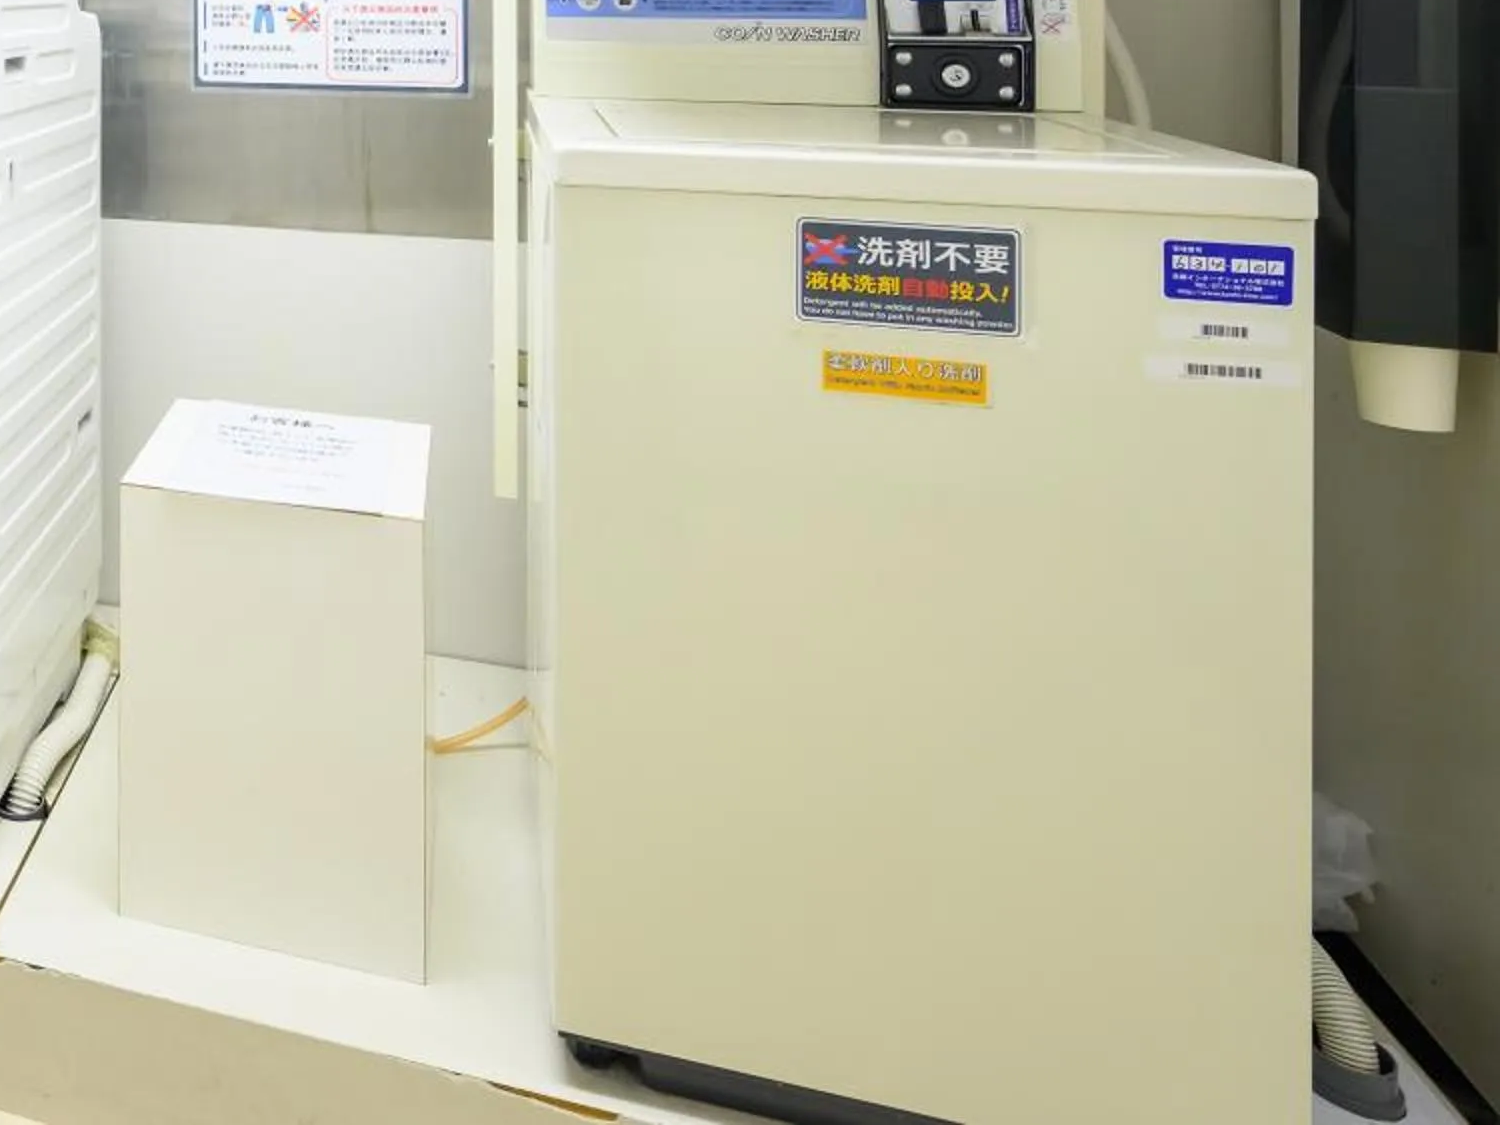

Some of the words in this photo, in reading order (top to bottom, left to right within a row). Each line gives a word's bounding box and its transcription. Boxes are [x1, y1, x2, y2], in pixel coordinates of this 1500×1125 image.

[776, 25, 861, 42] WASHER
[856, 235, 1011, 274] 洗剤不要
[805, 271, 1010, 303] 液体洗剤自動投入!
[828, 354, 982, 382] 柔軟剤入り洗剤
